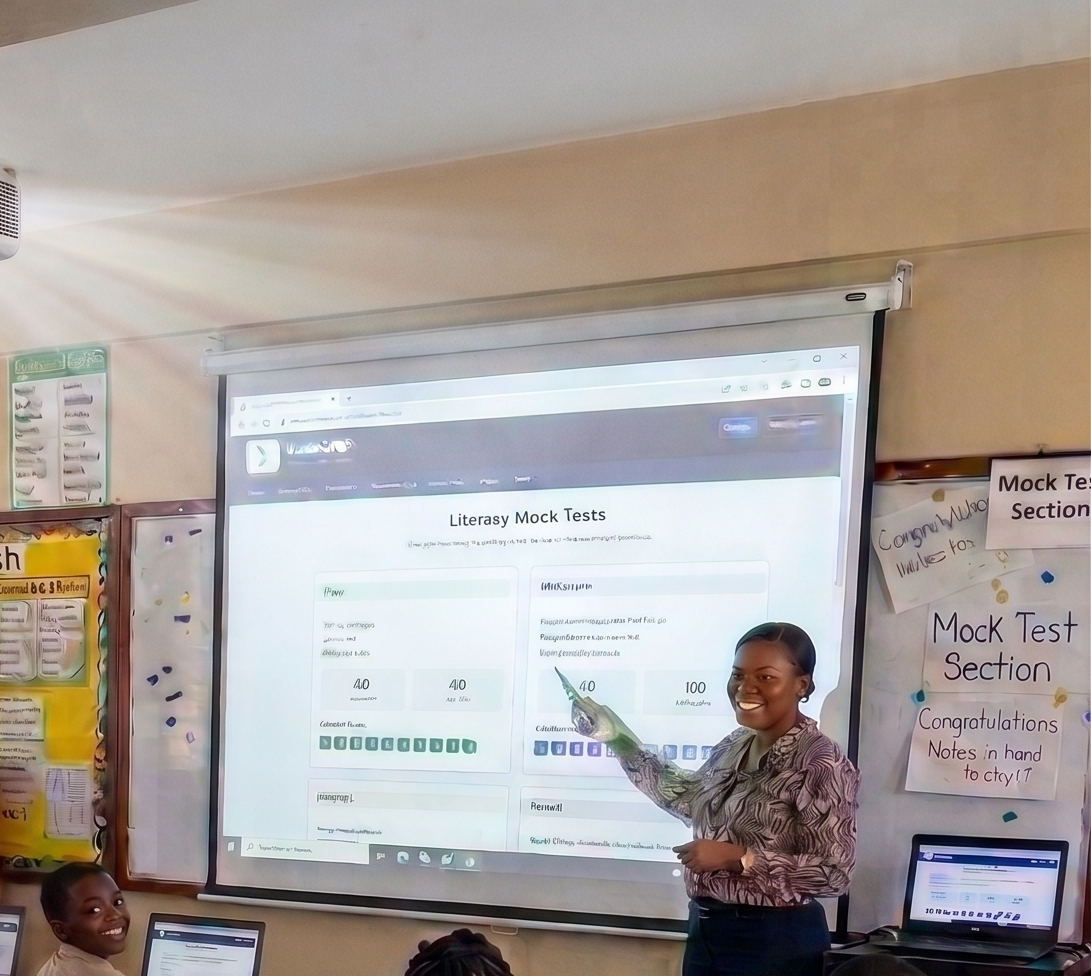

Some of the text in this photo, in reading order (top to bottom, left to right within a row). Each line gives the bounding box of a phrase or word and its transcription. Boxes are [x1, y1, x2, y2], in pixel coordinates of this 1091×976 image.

[998, 473, 1091, 492] Mock Te
[515, 510, 559, 525] Mock
[563, 507, 607, 522] Tests
[1011, 500, 1090, 520] Section
[933, 610, 1079, 644] Mock Test
[944, 651, 1051, 682] Section
[685, 681, 706, 694] 100
[918, 707, 1059, 738] Congratulations
[928, 739, 1042, 762] Notes in hand
[964, 763, 979, 781] to
